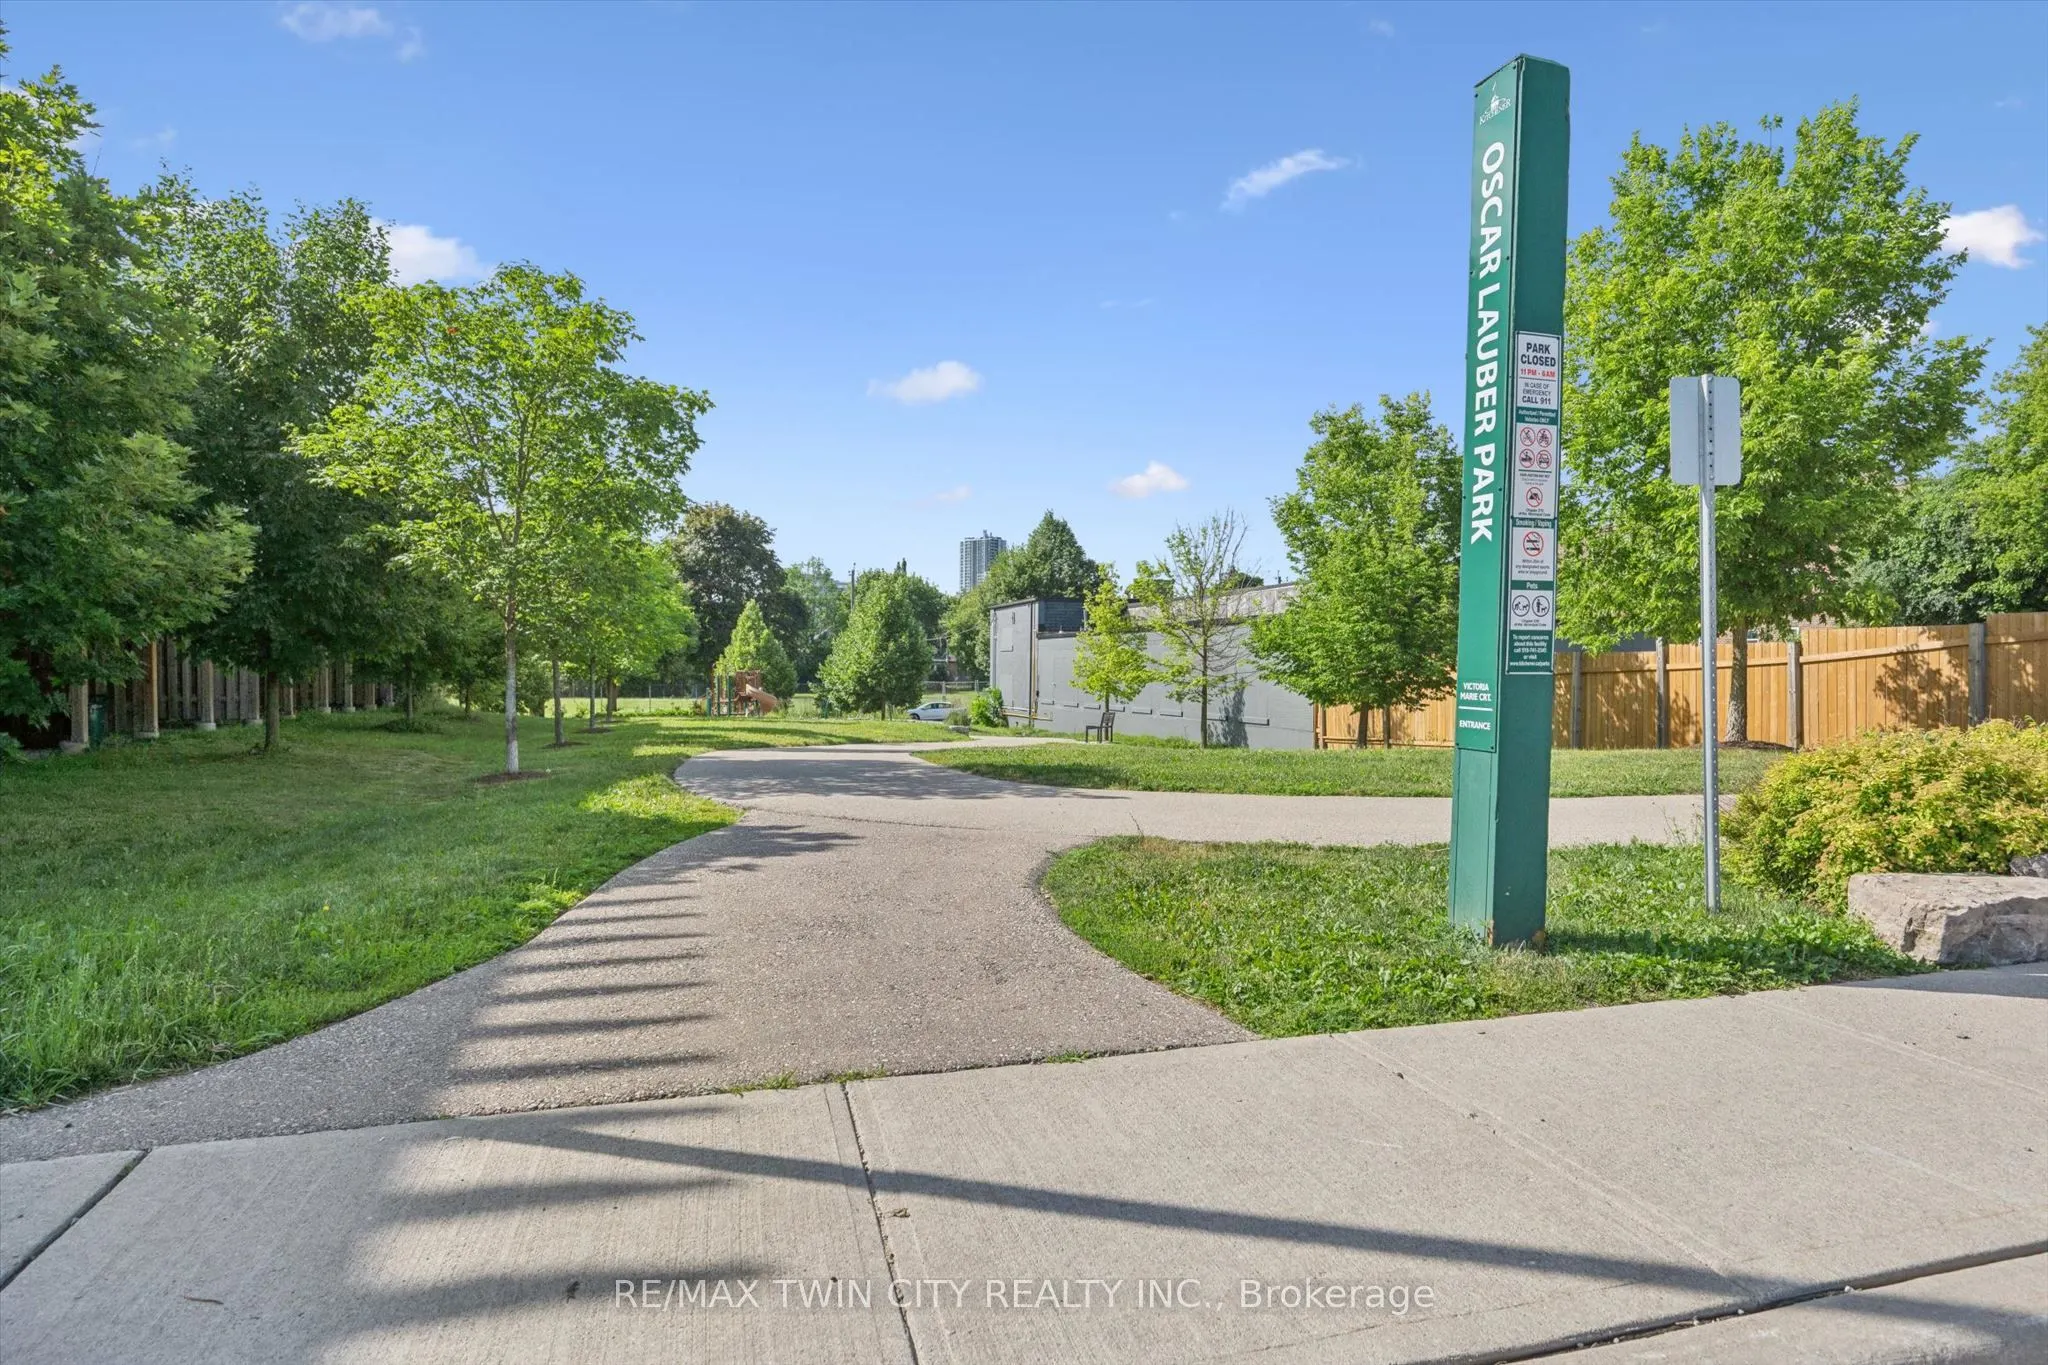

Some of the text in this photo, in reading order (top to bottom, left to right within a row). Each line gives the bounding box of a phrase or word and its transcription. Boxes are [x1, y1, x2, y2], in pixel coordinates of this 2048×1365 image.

[1471, 141, 1504, 544] OSCAR LAUBER PARK
[1526, 342, 1551, 354] PARK
[1521, 354, 1556, 367] CLOSED
[1522, 396, 1551, 405] CALL 911
[1516, 519, 1534, 528] Smoking
[1463, 682, 1489, 691] VICTORIA
[1460, 692, 1478, 700] MARIE
[1459, 720, 1491, 730] ENTRANCE
